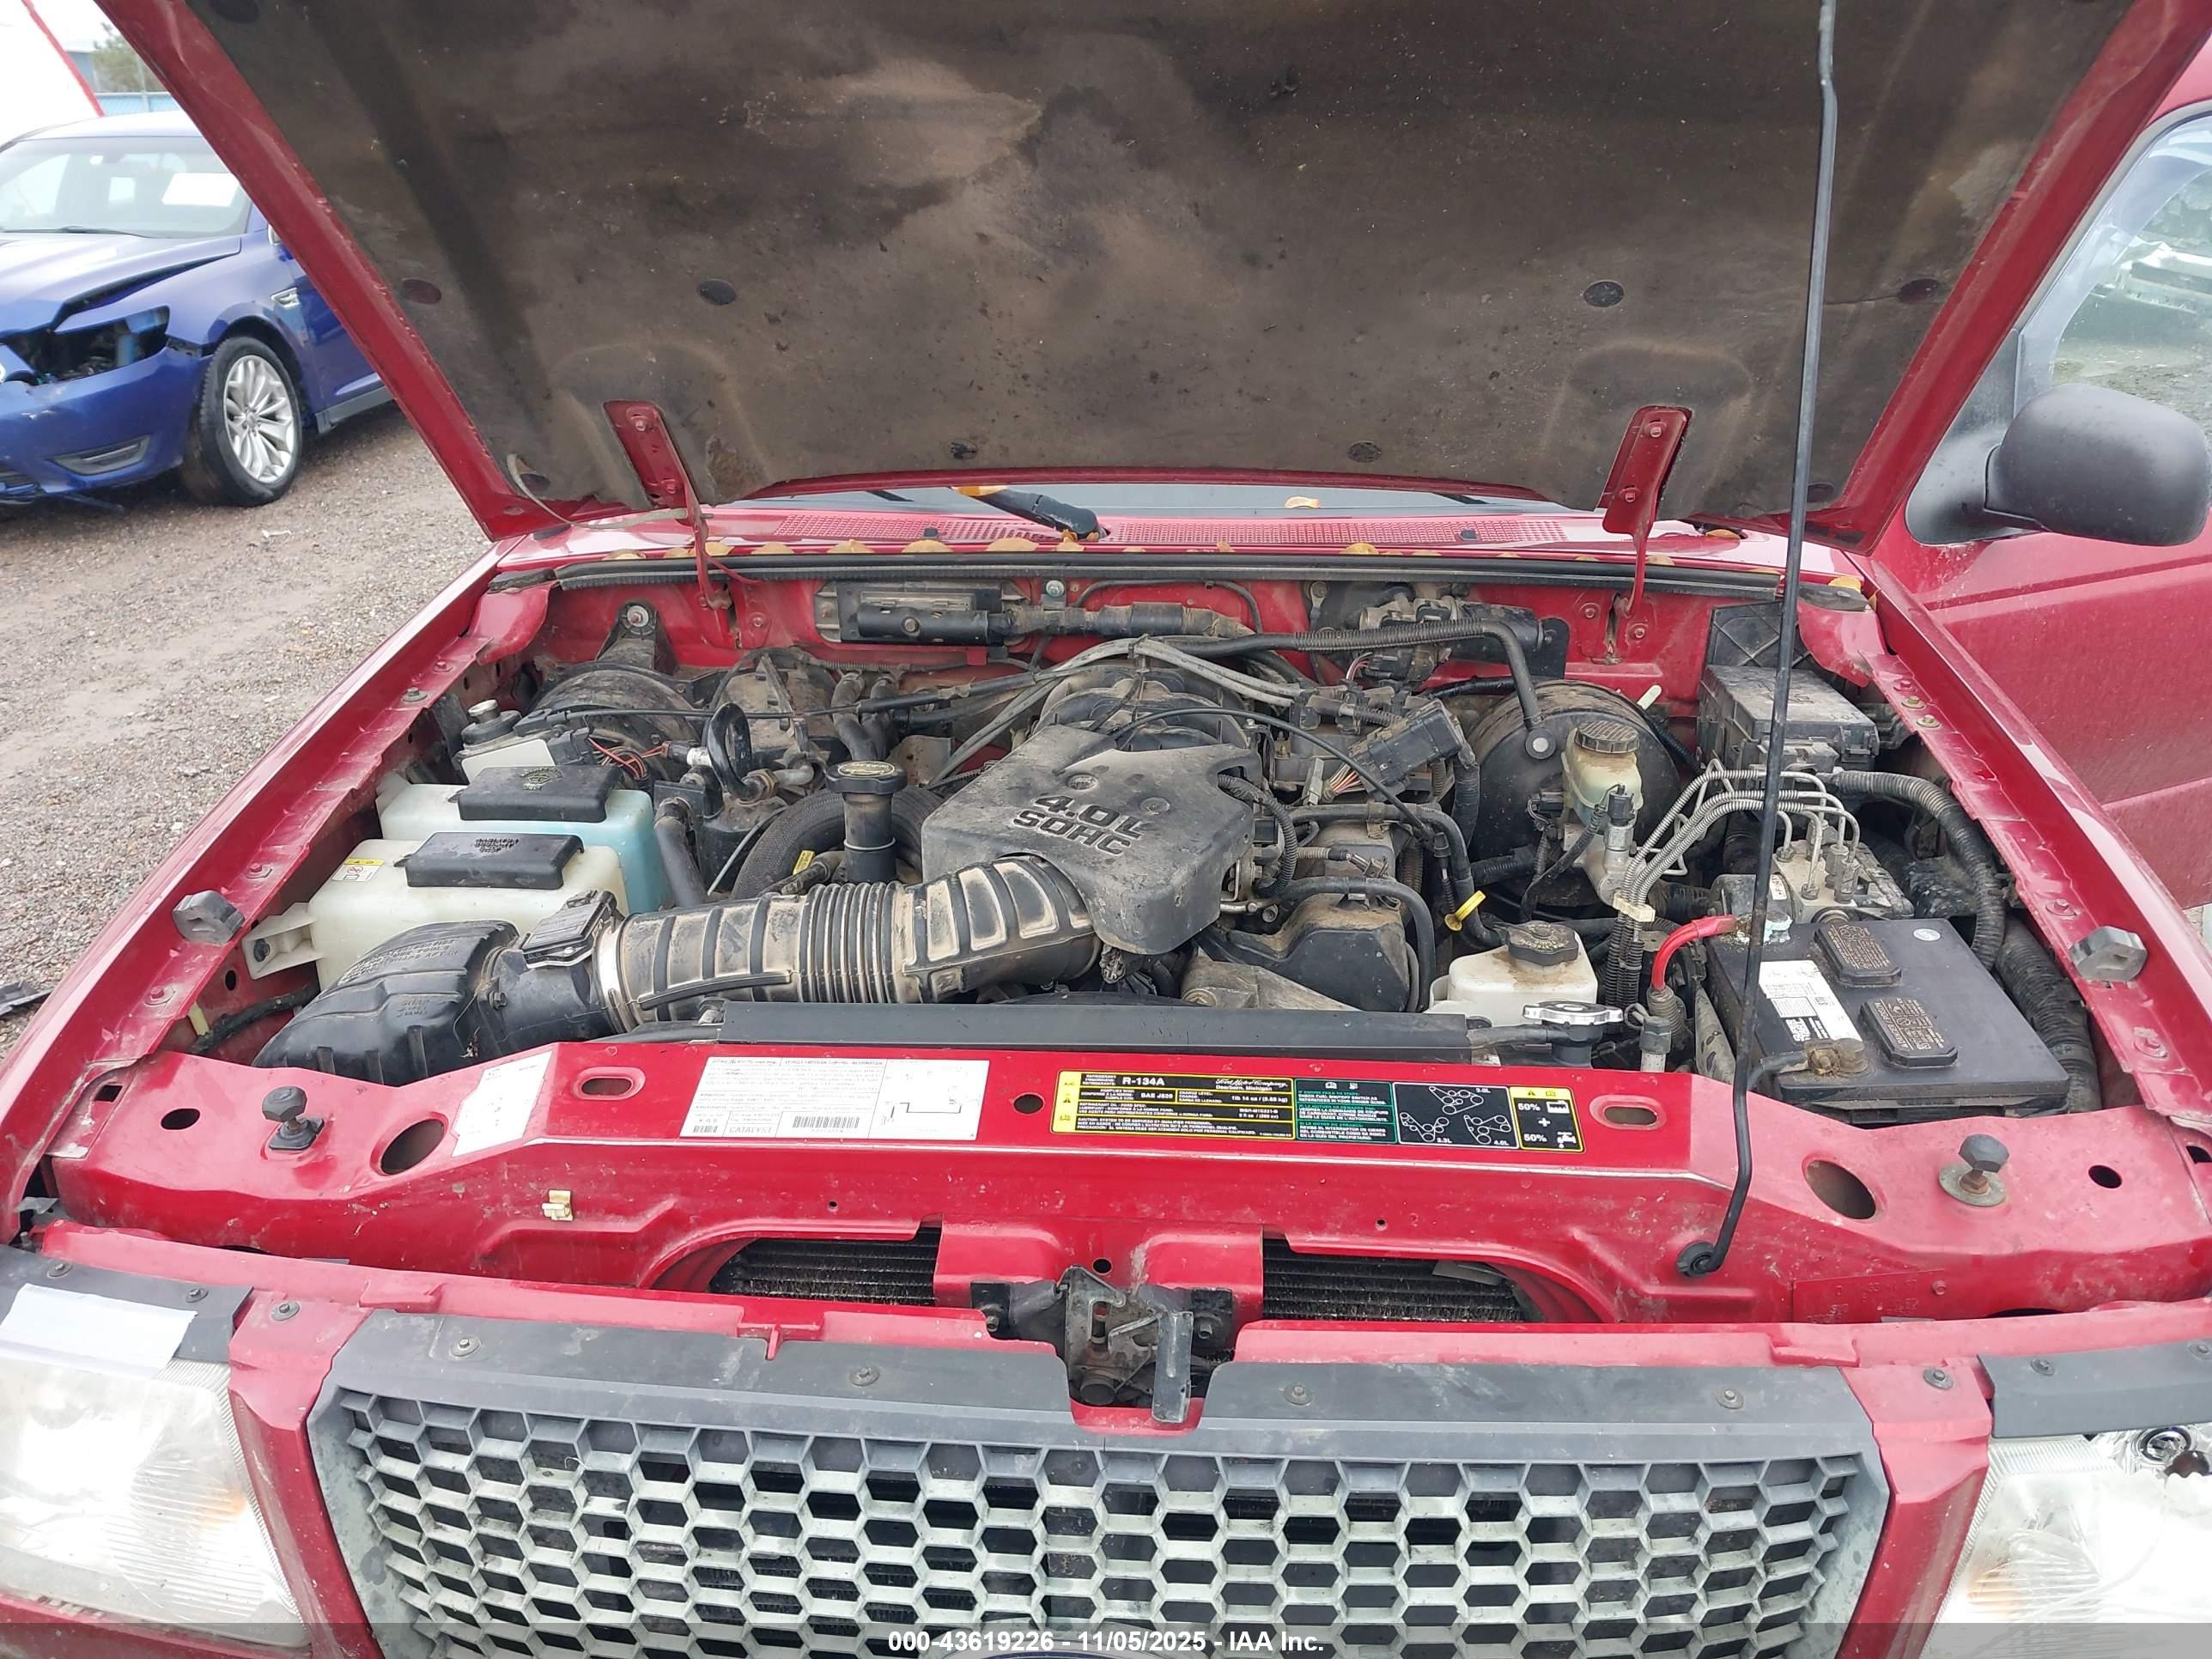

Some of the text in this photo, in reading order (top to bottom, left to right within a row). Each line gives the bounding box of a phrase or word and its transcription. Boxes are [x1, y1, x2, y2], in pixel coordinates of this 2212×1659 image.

[1034, 794, 1143, 838] 4.0L
[1012, 809, 1133, 855] SOHC
[1122, 1077, 1165, 1085] R-134A
[1517, 1103, 1540, 1111] 50%
[1523, 1133, 1547, 1142] 50%
